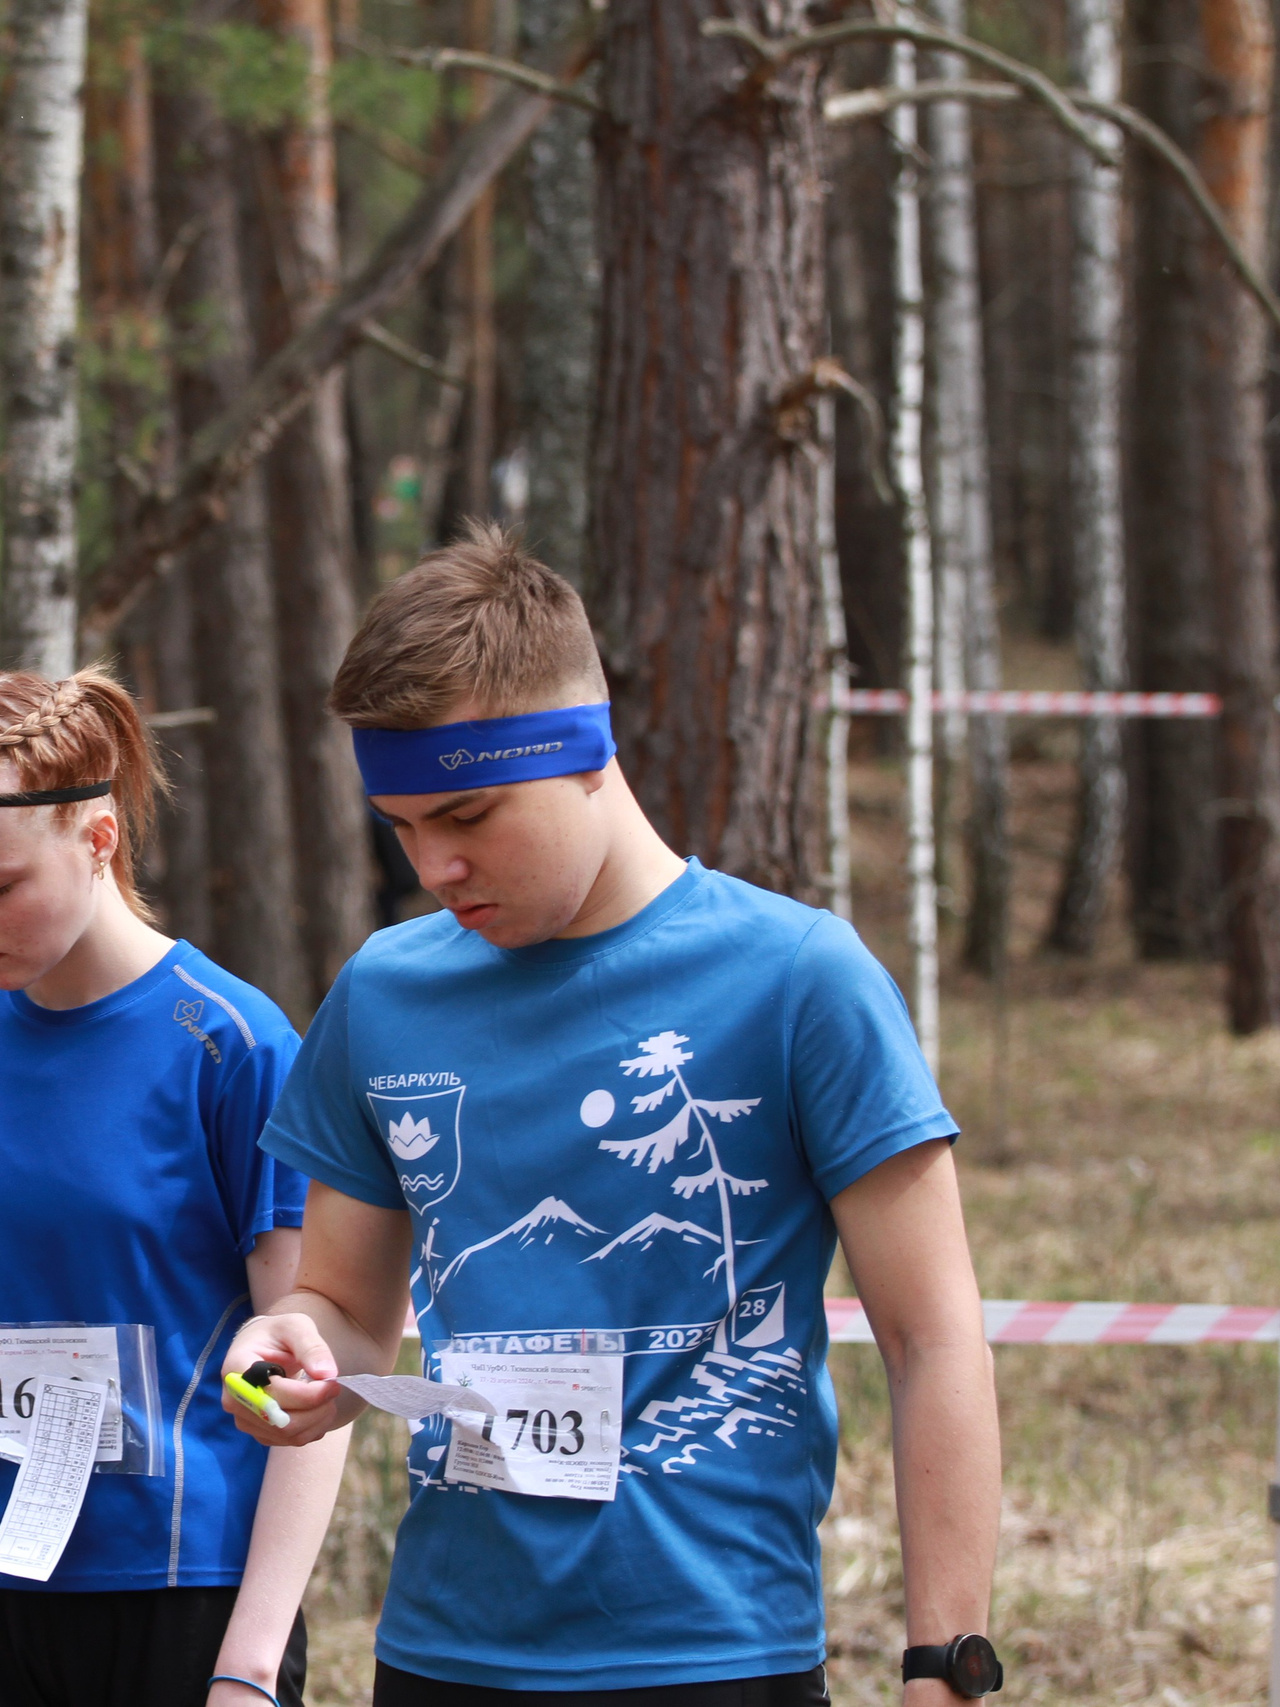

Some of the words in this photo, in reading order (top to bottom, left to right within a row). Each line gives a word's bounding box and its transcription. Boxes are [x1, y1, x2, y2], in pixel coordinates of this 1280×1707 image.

[476, 741, 563, 762] NORD
[180, 1020, 222, 1064] NORD
[368, 1072, 462, 1090] ЧЕБАРКУЛЬ
[738, 1299, 766, 1317] 28
[454, 1333, 626, 1354] ЭСТАФЕТЫ
[648, 1325, 717, 1349] 2022
